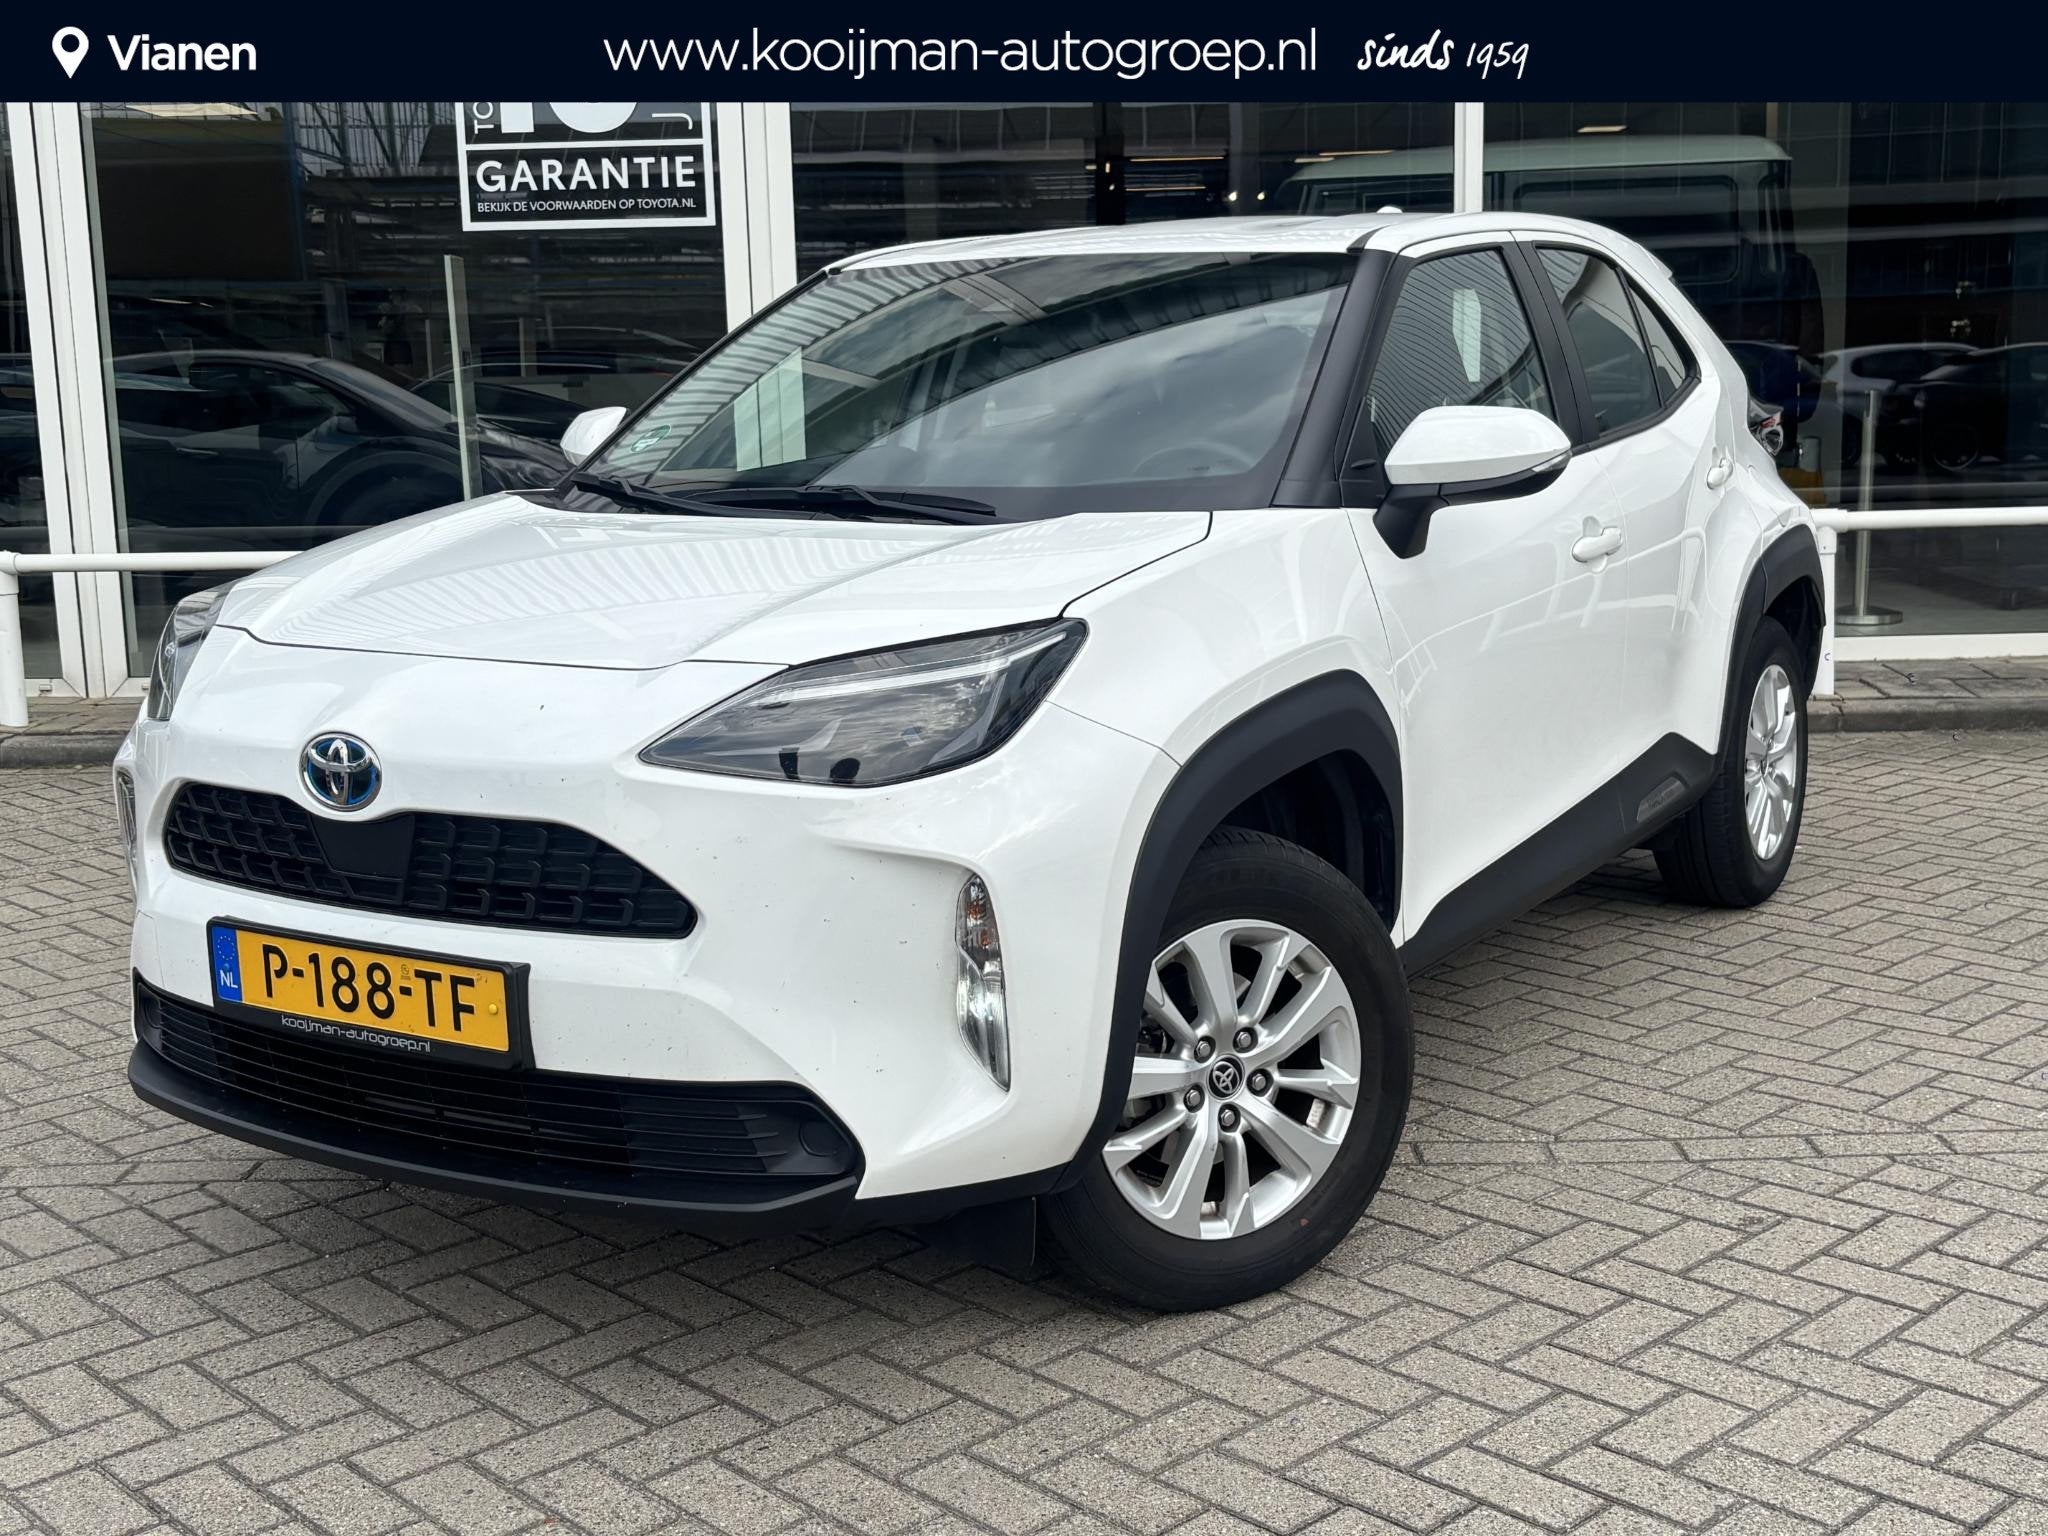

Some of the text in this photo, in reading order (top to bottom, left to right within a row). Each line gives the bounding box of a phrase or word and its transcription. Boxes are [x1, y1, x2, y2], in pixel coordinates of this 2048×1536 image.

[476, 155, 696, 193] GARANTIE
[477, 198, 697, 213] BEKIJK DE VOORWAARDEN OP TOYOTA.NL
[220, 971, 239, 989] NL
[262, 943, 476, 1032] P-188-TF
[281, 1014, 431, 1053] kooijman-autogroep.nl
